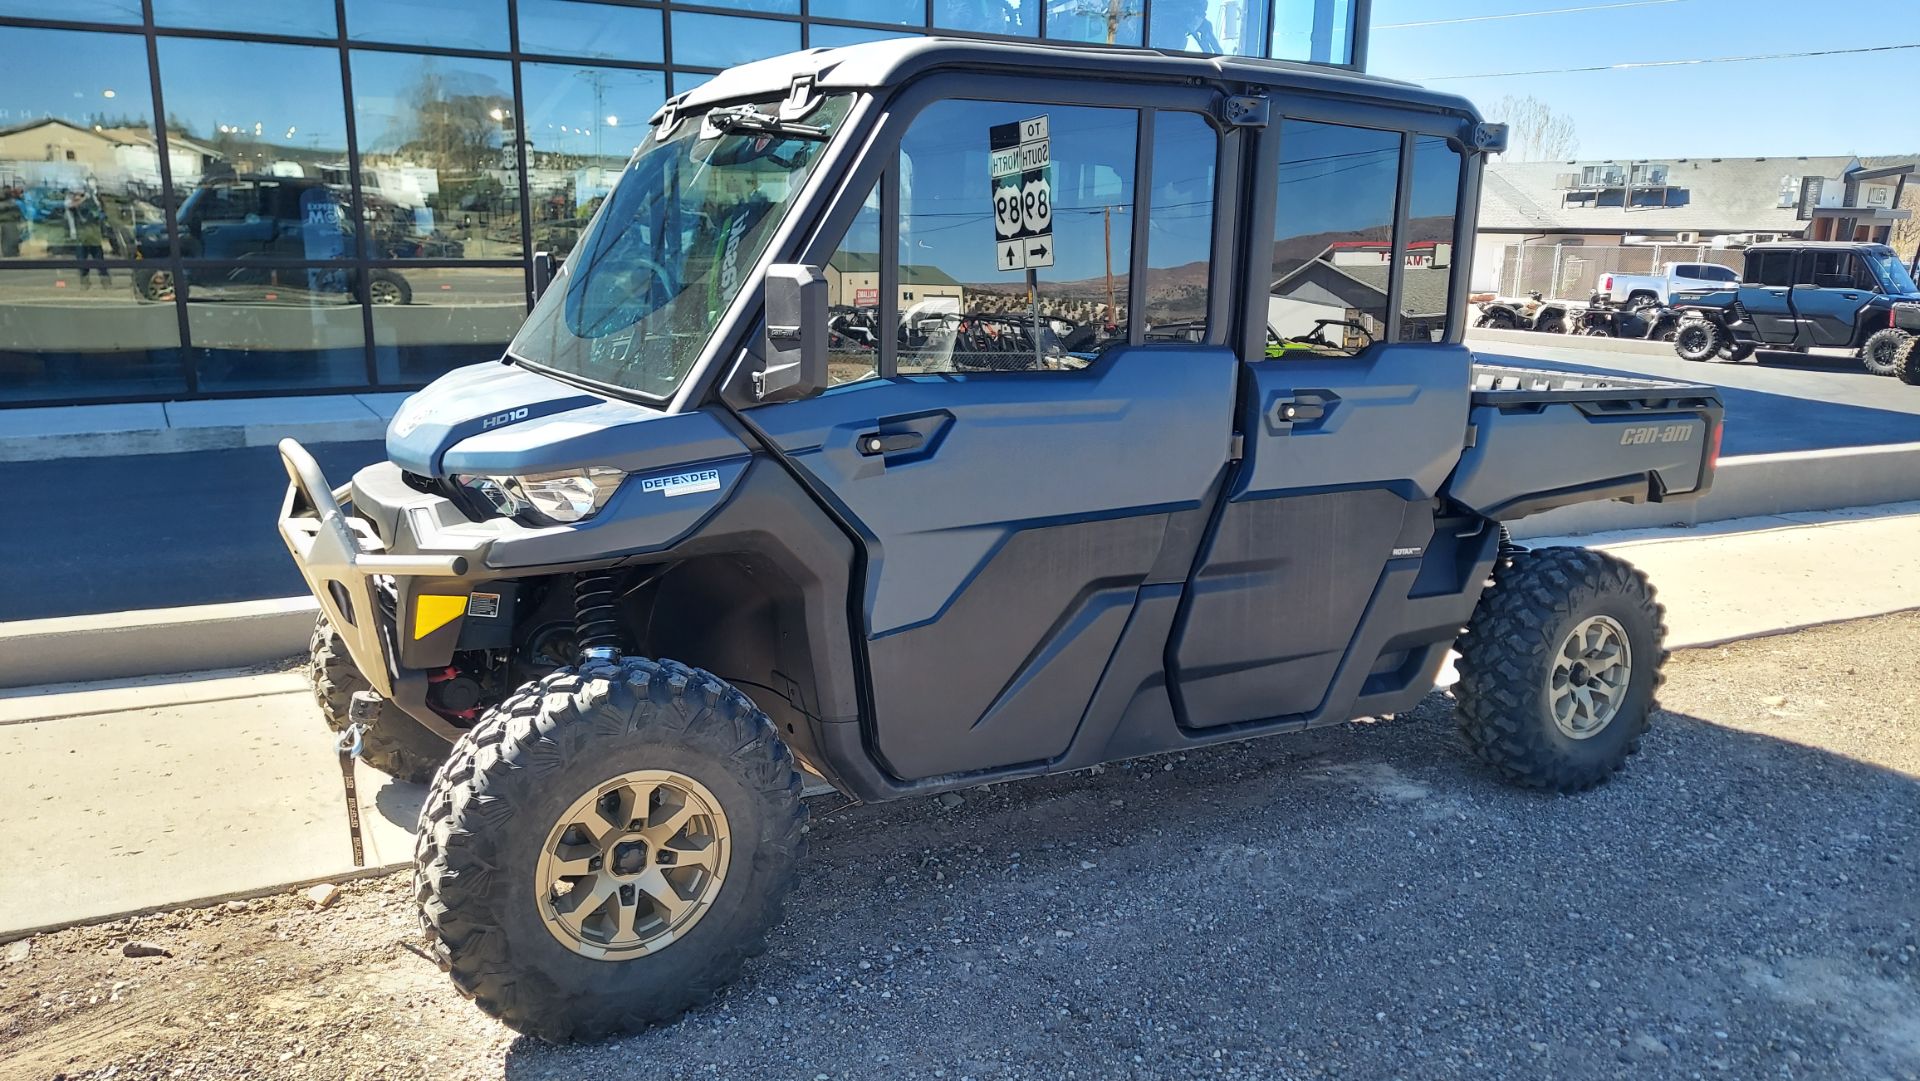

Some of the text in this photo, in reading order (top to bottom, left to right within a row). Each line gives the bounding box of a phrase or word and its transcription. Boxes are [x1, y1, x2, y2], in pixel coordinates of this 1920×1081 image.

[483, 408, 528, 429] HD10
[1620, 425, 1693, 445] can-am
[644, 471, 717, 489] DEFENDER
